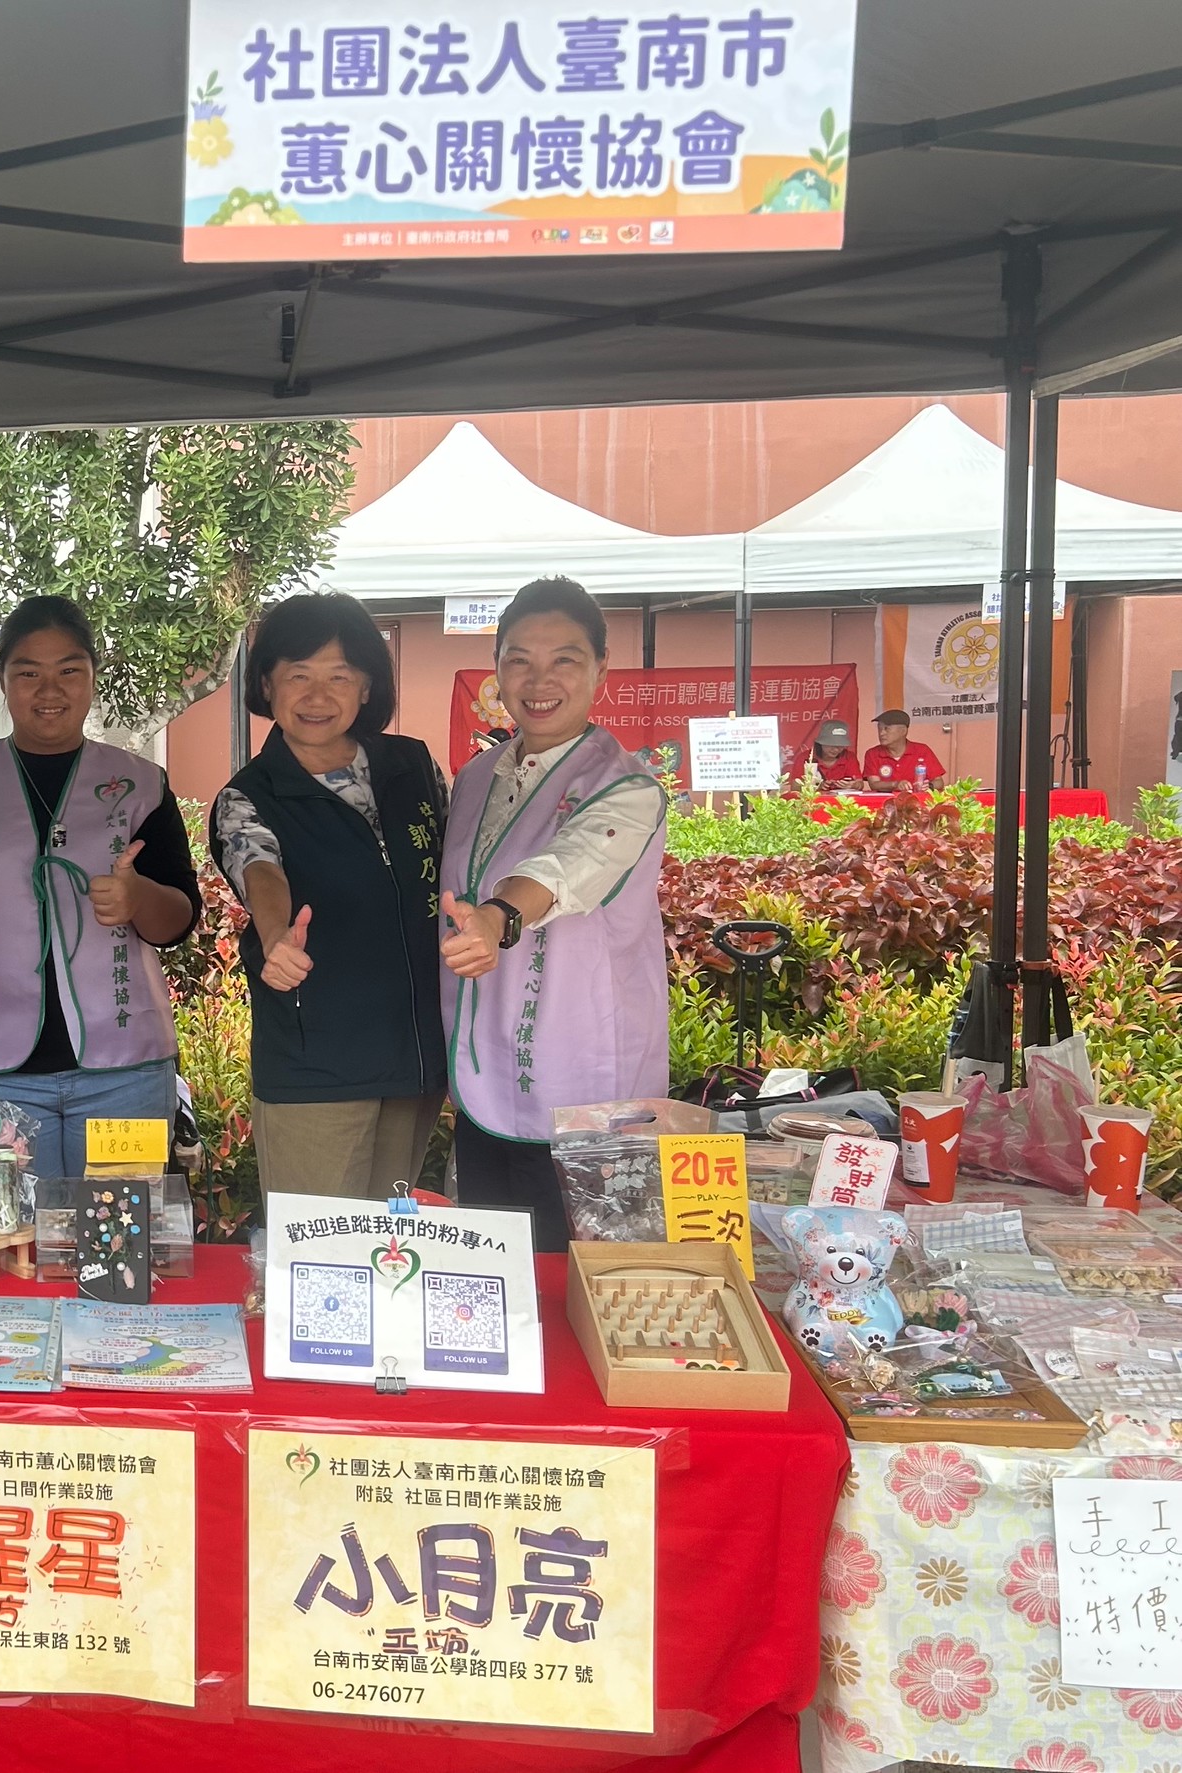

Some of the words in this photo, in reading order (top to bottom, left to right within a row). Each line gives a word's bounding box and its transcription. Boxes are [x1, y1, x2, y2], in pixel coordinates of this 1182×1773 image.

[242, 8, 794, 103] 社團法人臺南市
[279, 110, 744, 197] 蕙心關懷協會
[450, 615, 499, 625] 無聲記憶力
[592, 676, 841, 706] 人台南市聽障體運動協會
[951, 693, 986, 703] 社團法人
[587, 715, 650, 727] ATHLETIC
[803, 709, 839, 721] DEAF
[912, 703, 998, 717] 台南市聽障體育運
[671, 1151, 739, 1187] 20元
[831, 1142, 875, 1206] 發財筒
[697, 1194, 720, 1202] PLAY
[285, 1214, 507, 1254] 歡迎追蹤我們的粉專^^
[677, 1209, 744, 1243] 三次
[310, 1347, 342, 1356] FOLLOW
[342, 1348, 353, 1357] US
[444, 1355, 475, 1364] FOLLOW
[477, 1357, 488, 1365] US
[329, 1457, 606, 1488] 社團法人臺南市蕙心關懷協會
[355, 1485, 394, 1504] 附設
[405, 1487, 562, 1513] 社區日間作業設施
[293, 1522, 609, 1644] 小月亮
[1086, 1586, 1168, 1635] 特價
[74, 1633, 108, 1653] 132
[113, 1636, 131, 1655] 號
[313, 1649, 528, 1681] 台南市安南區公學路四段
[532, 1663, 569, 1682] 377
[574, 1664, 594, 1684] 號
[312, 1680, 426, 1704] 06-2476077
